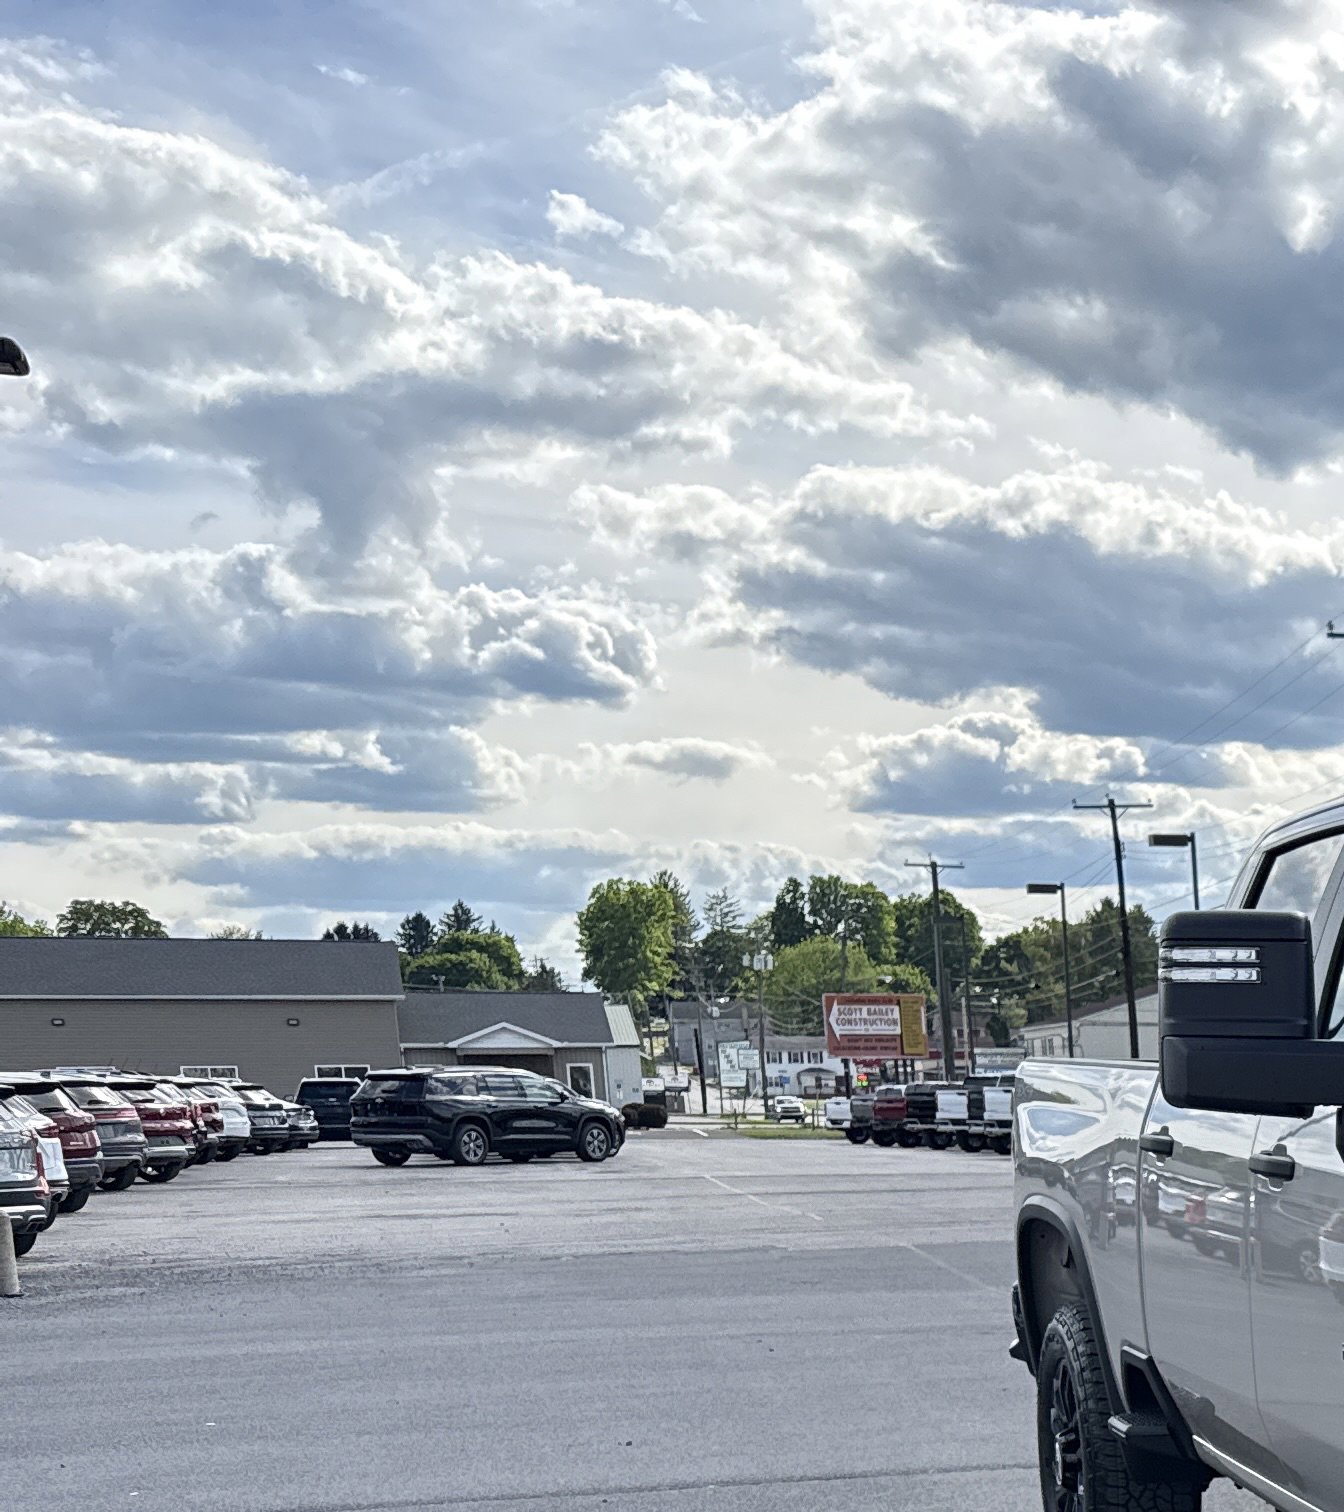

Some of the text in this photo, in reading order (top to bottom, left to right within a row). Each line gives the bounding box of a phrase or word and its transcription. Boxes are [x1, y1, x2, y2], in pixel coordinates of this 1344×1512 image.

[837, 1007, 895, 1017] SCOTT BAILEY
[835, 1018, 899, 1027] CONSTRUCTION
